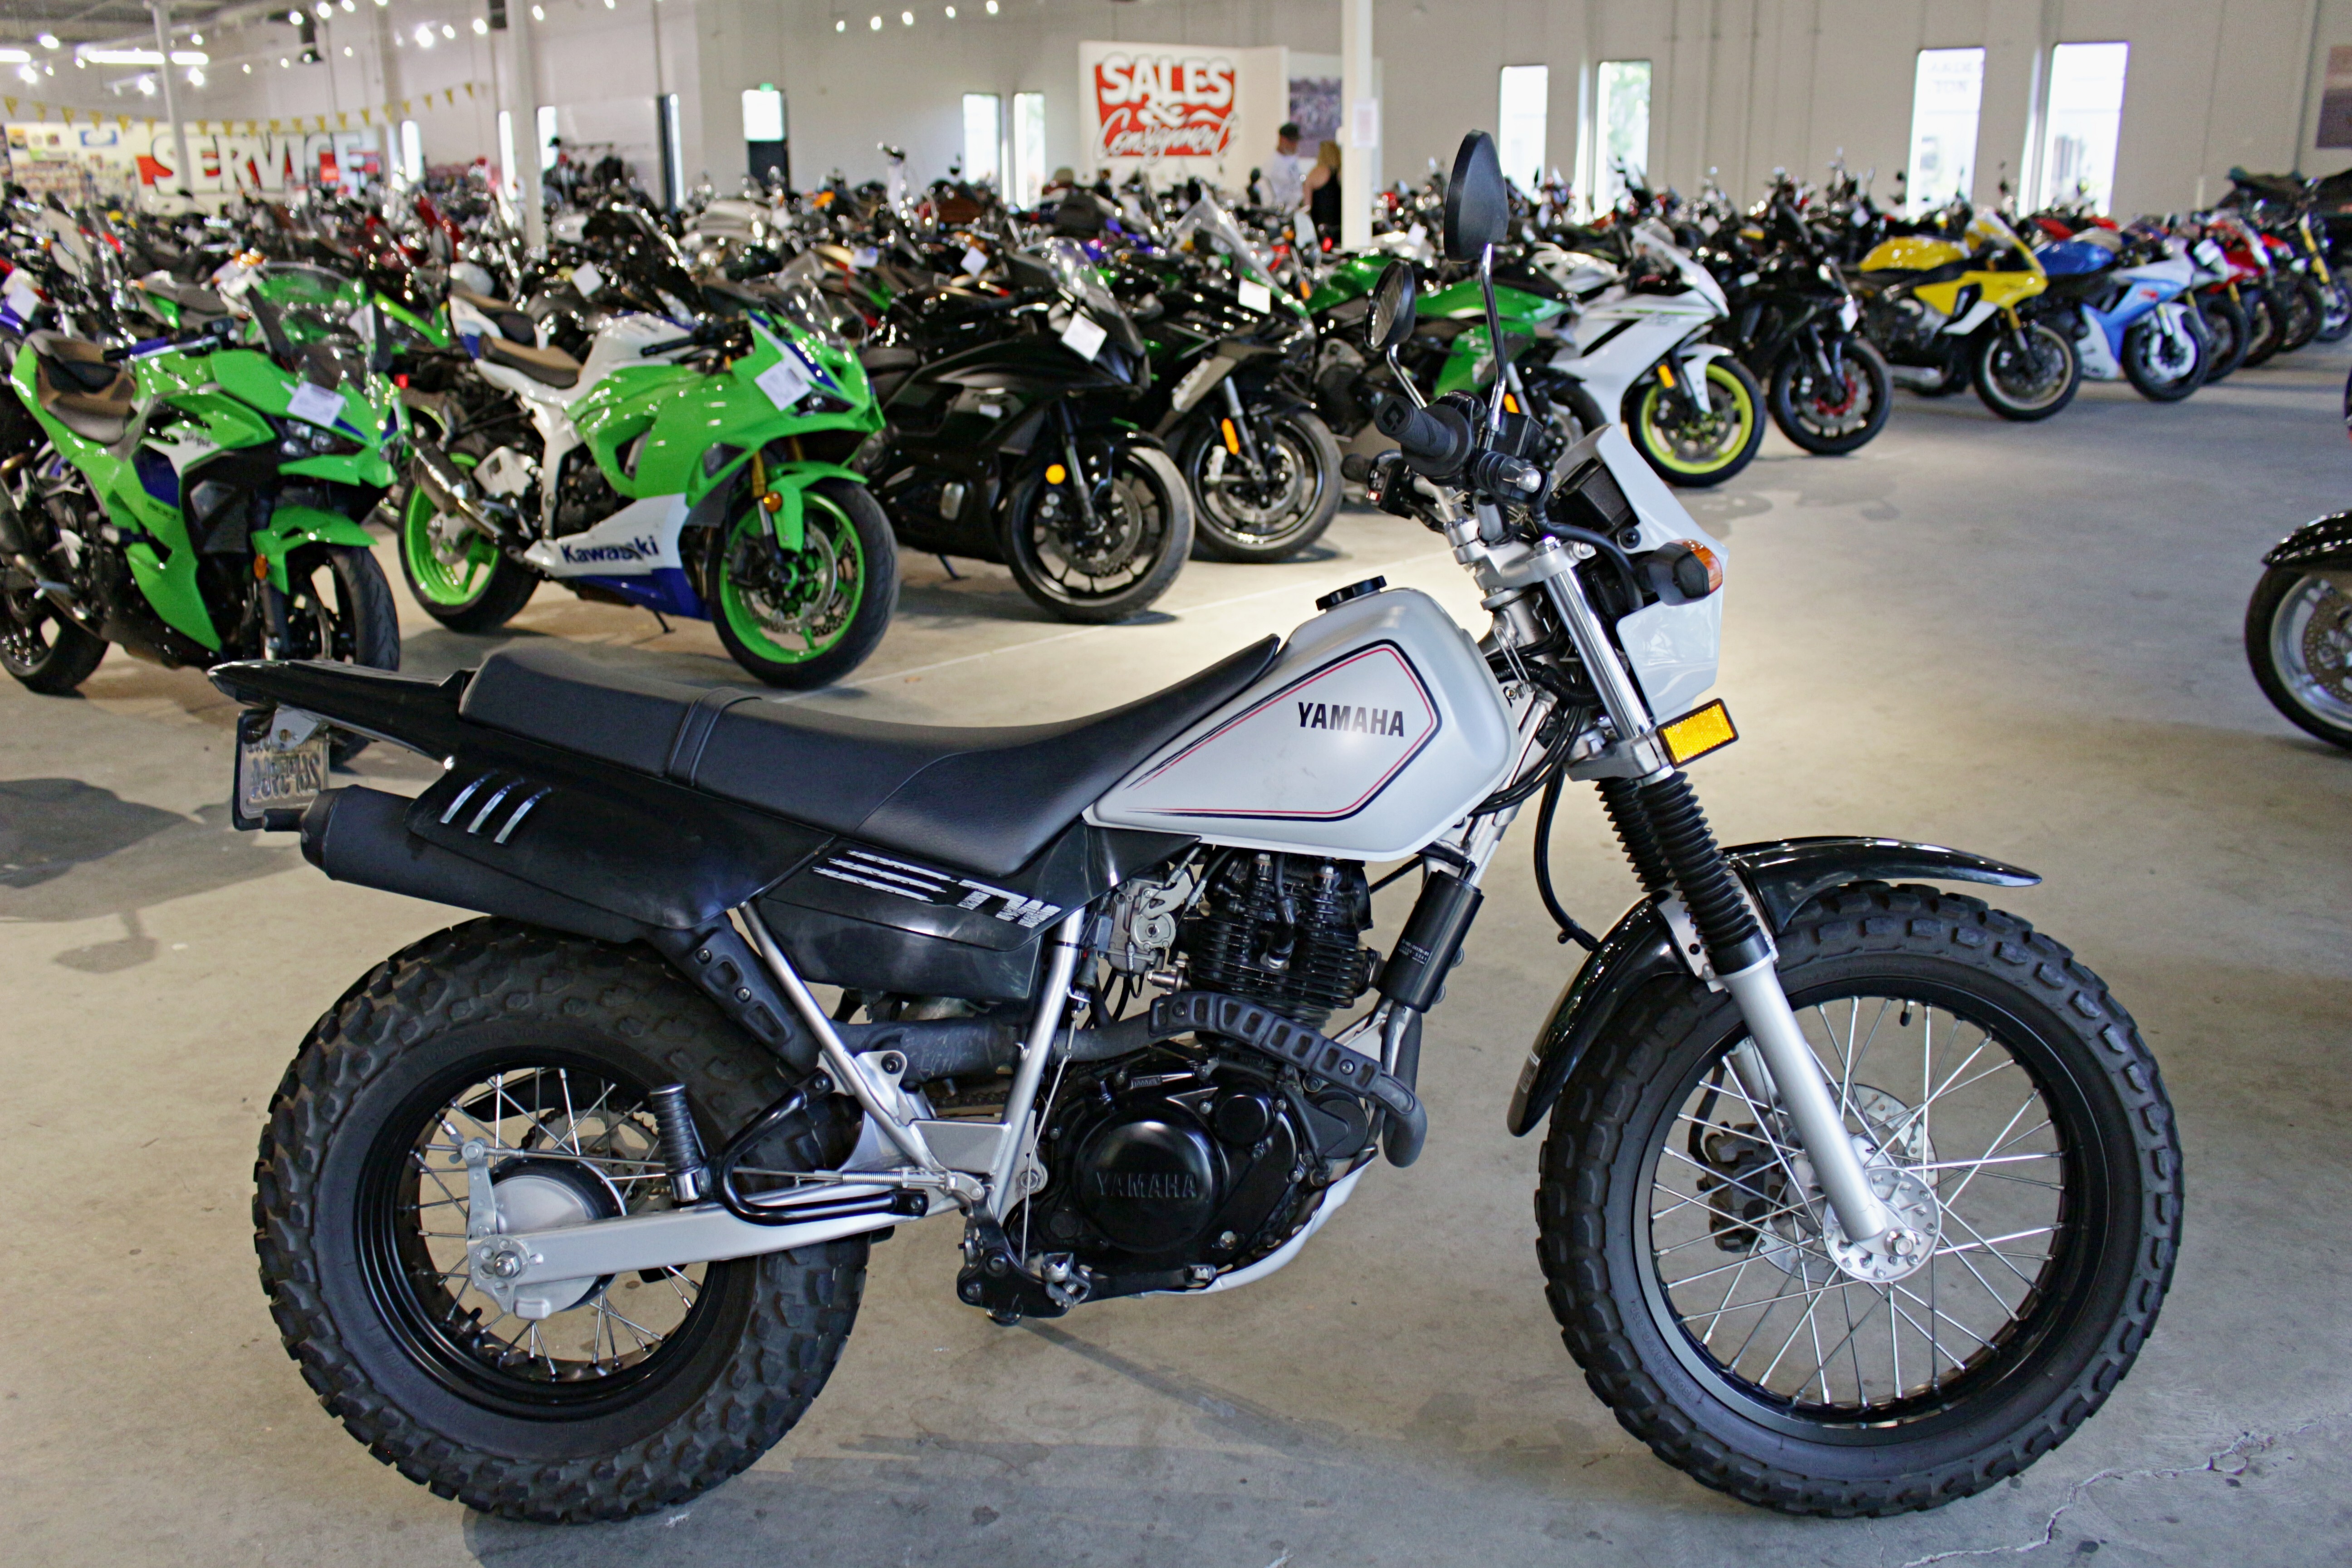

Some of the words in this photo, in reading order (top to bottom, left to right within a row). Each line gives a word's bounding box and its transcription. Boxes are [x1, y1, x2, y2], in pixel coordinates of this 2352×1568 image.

[1100, 53, 1233, 109] SALES
[152, 131, 363, 196] SERVICE
[560, 535, 659, 564] Kawasaki
[1298, 702, 1404, 737] YAMAHA
[957, 879, 1062, 929] TW
[1096, 1171, 1197, 1198] YAMAHA
